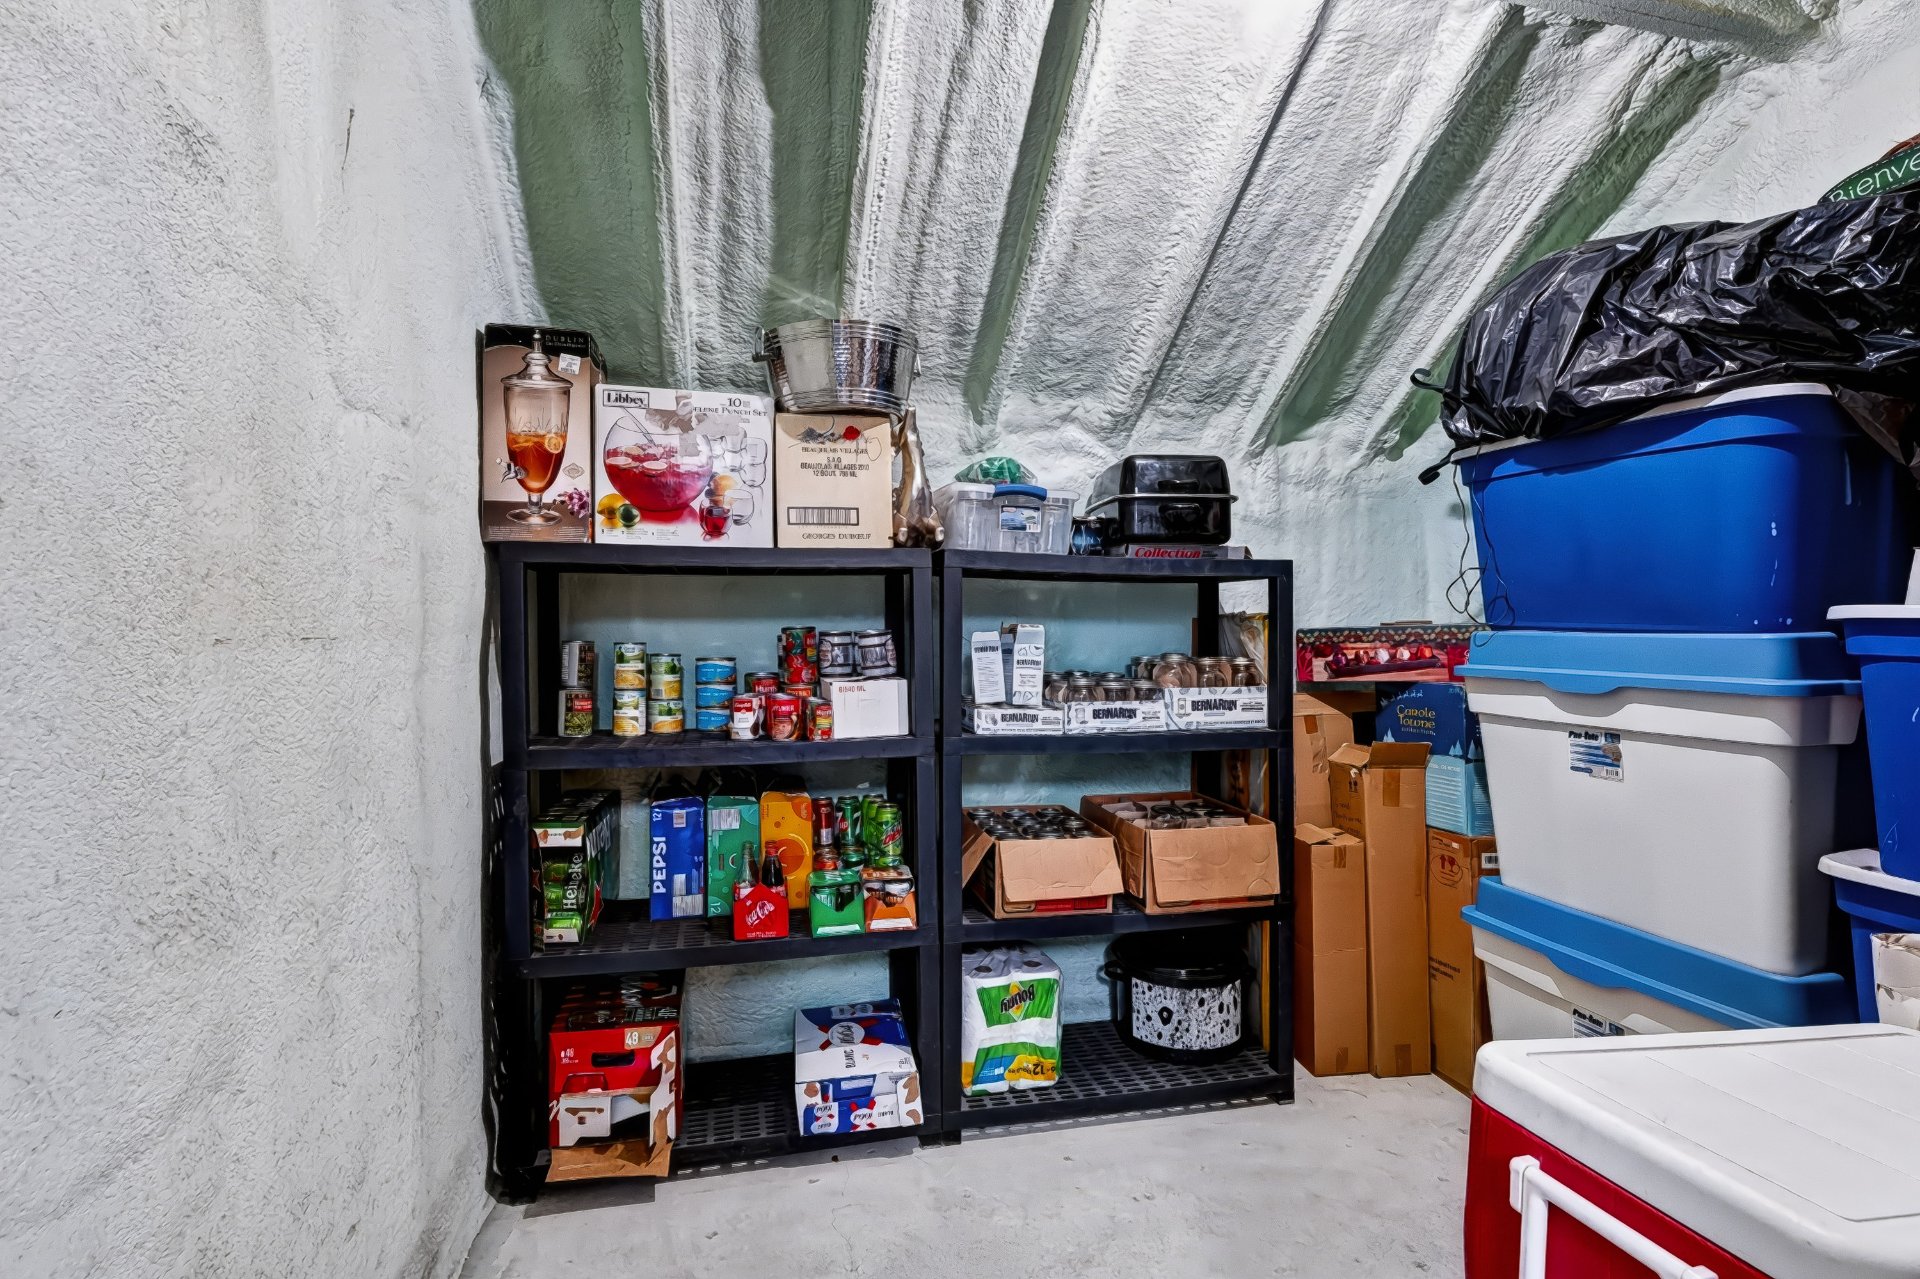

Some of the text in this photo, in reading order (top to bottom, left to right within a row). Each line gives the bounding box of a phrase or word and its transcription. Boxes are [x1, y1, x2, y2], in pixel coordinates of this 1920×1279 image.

[545, 335, 584, 343] DUBLIN
[606, 392, 645, 407] Libbey
[728, 398, 742, 407] 10
[1135, 546, 1201, 558] Collection
[1191, 699, 1238, 712] BERNARDIN
[1396, 704, 1436, 719] Carole
[1001, 713, 1039, 723] BERNARDIN
[1092, 707, 1137, 719] BERNARDIN
[1397, 714, 1436, 729] Towne
[652, 836, 667, 894] PEPSI
[710, 901, 721, 914] 12
[1000, 983, 1036, 1013] Bounty
[626, 1031, 639, 1046] 48
[1032, 1063, 1045, 1076] 12
